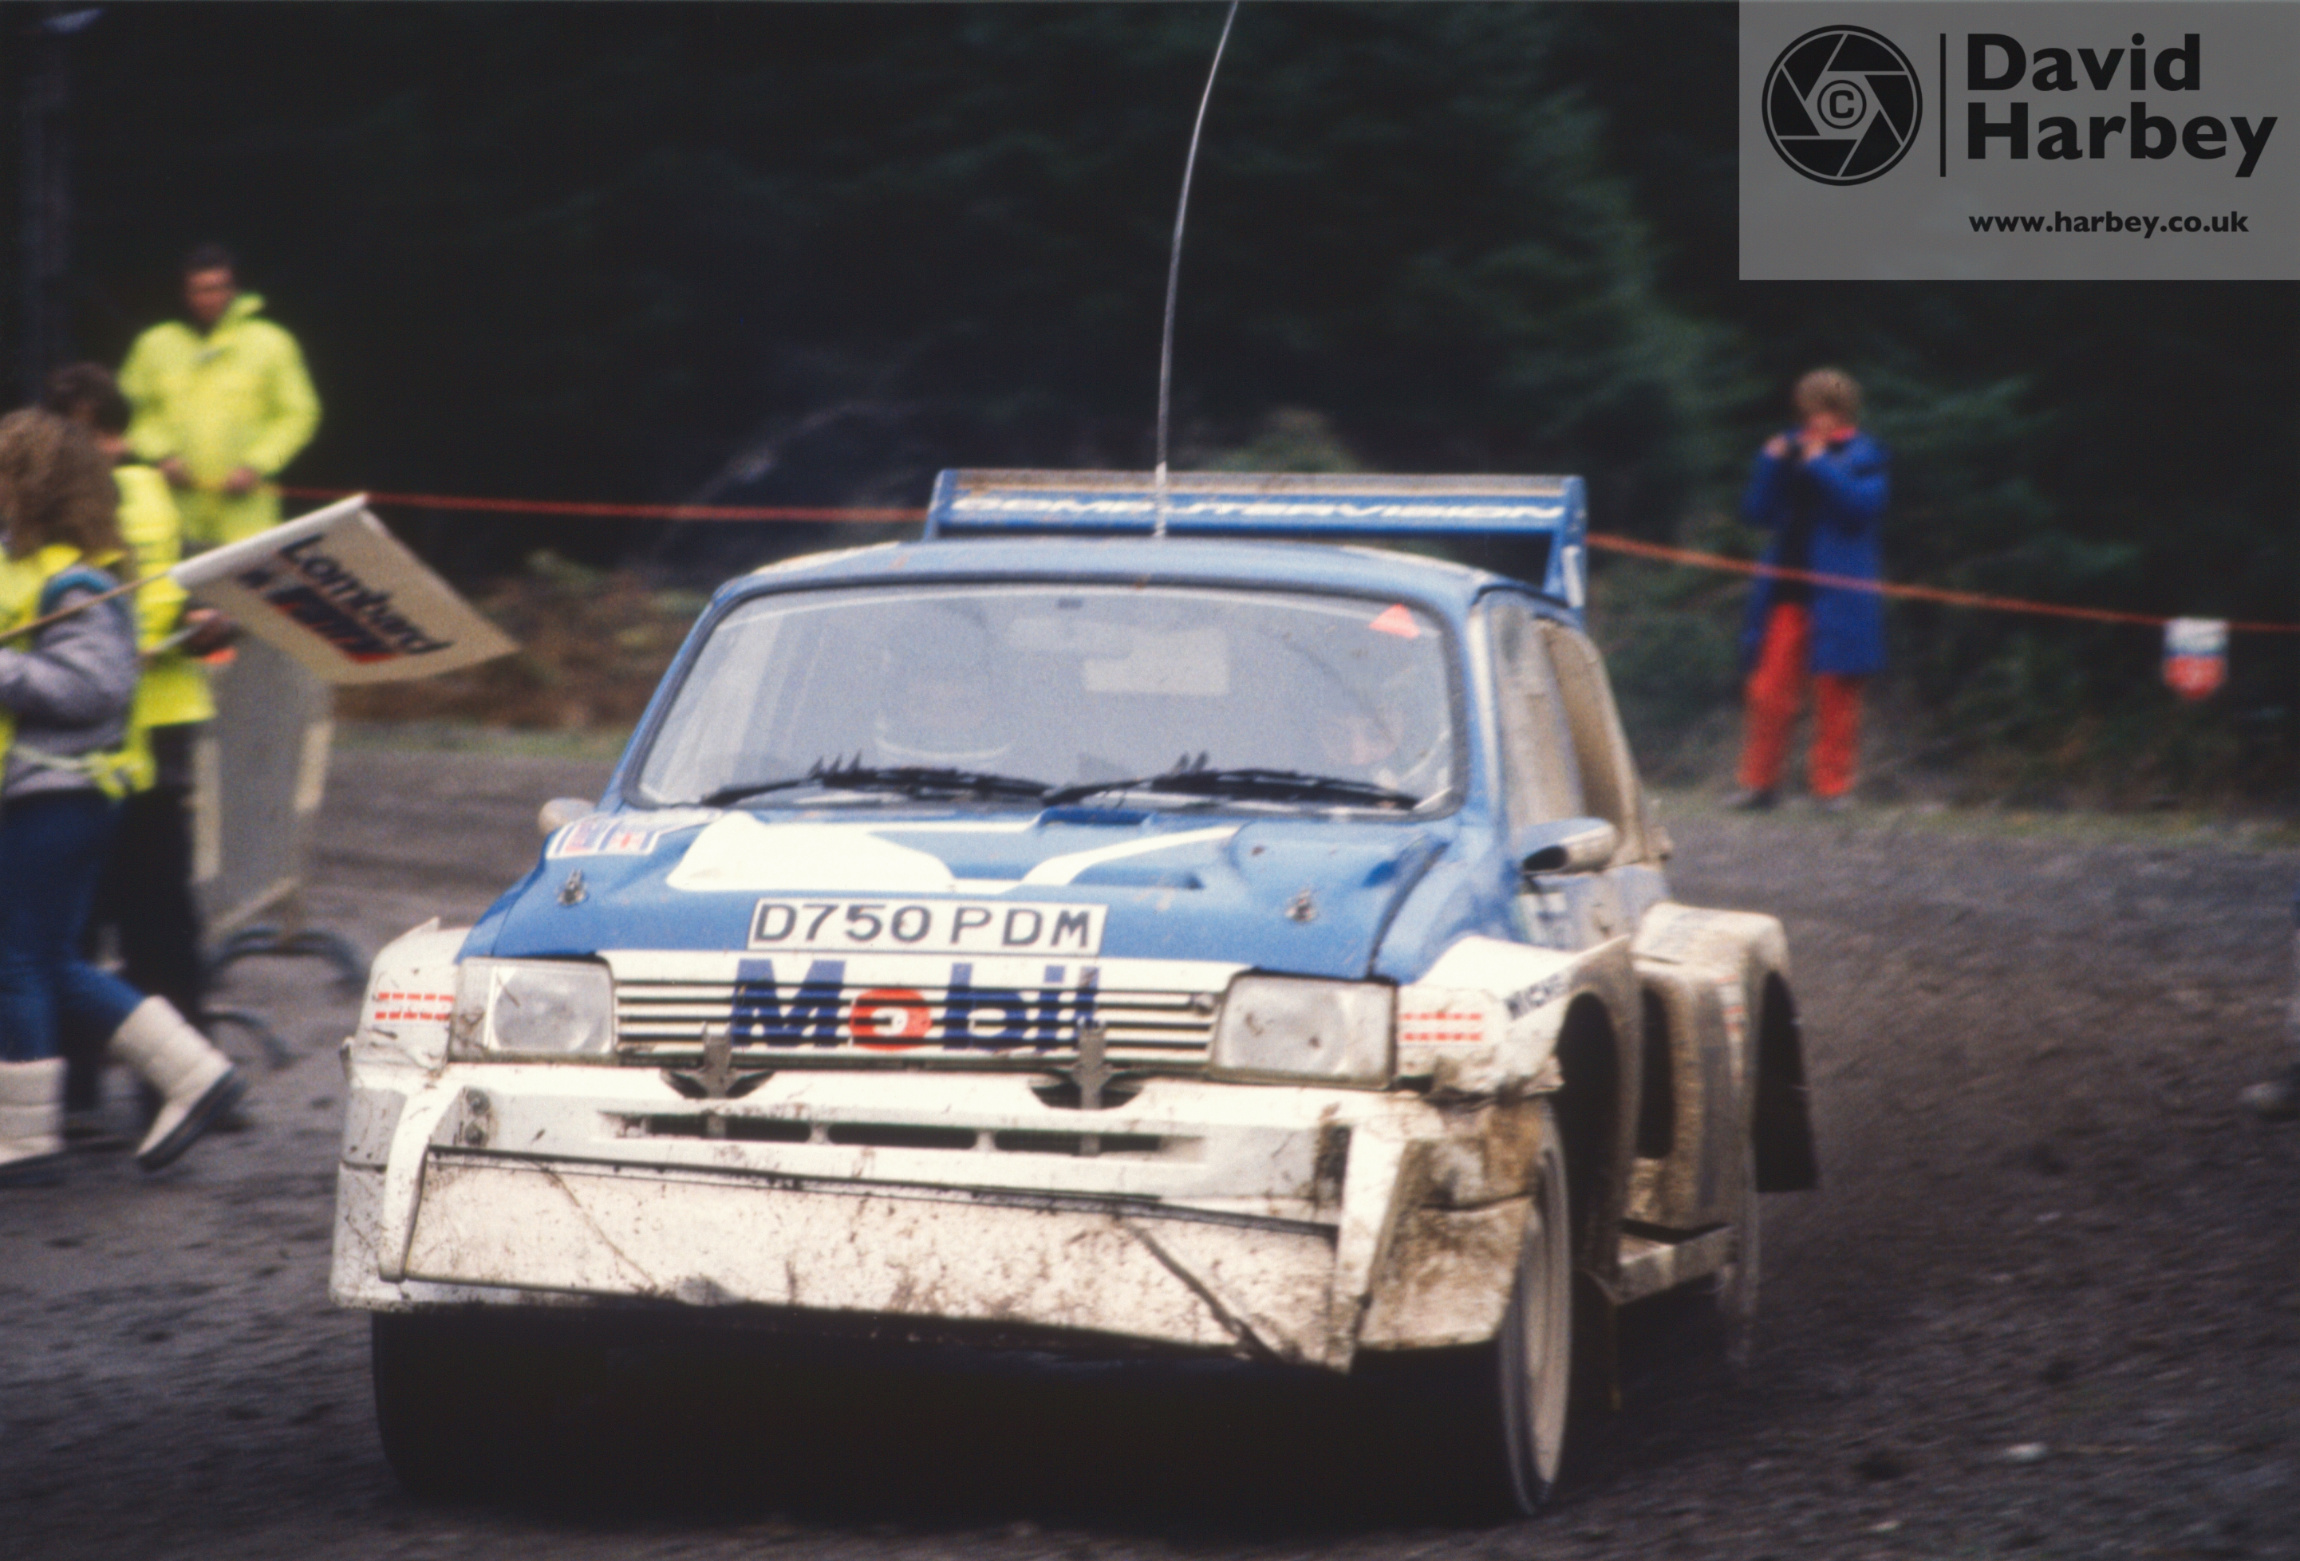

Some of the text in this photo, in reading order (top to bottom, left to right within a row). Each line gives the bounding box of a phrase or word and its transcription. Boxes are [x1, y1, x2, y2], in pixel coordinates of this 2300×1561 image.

[278, 532, 455, 656] Lombard
[754, 903, 1091, 948] D750 PDM
[730, 958, 1101, 1053] Mobil
